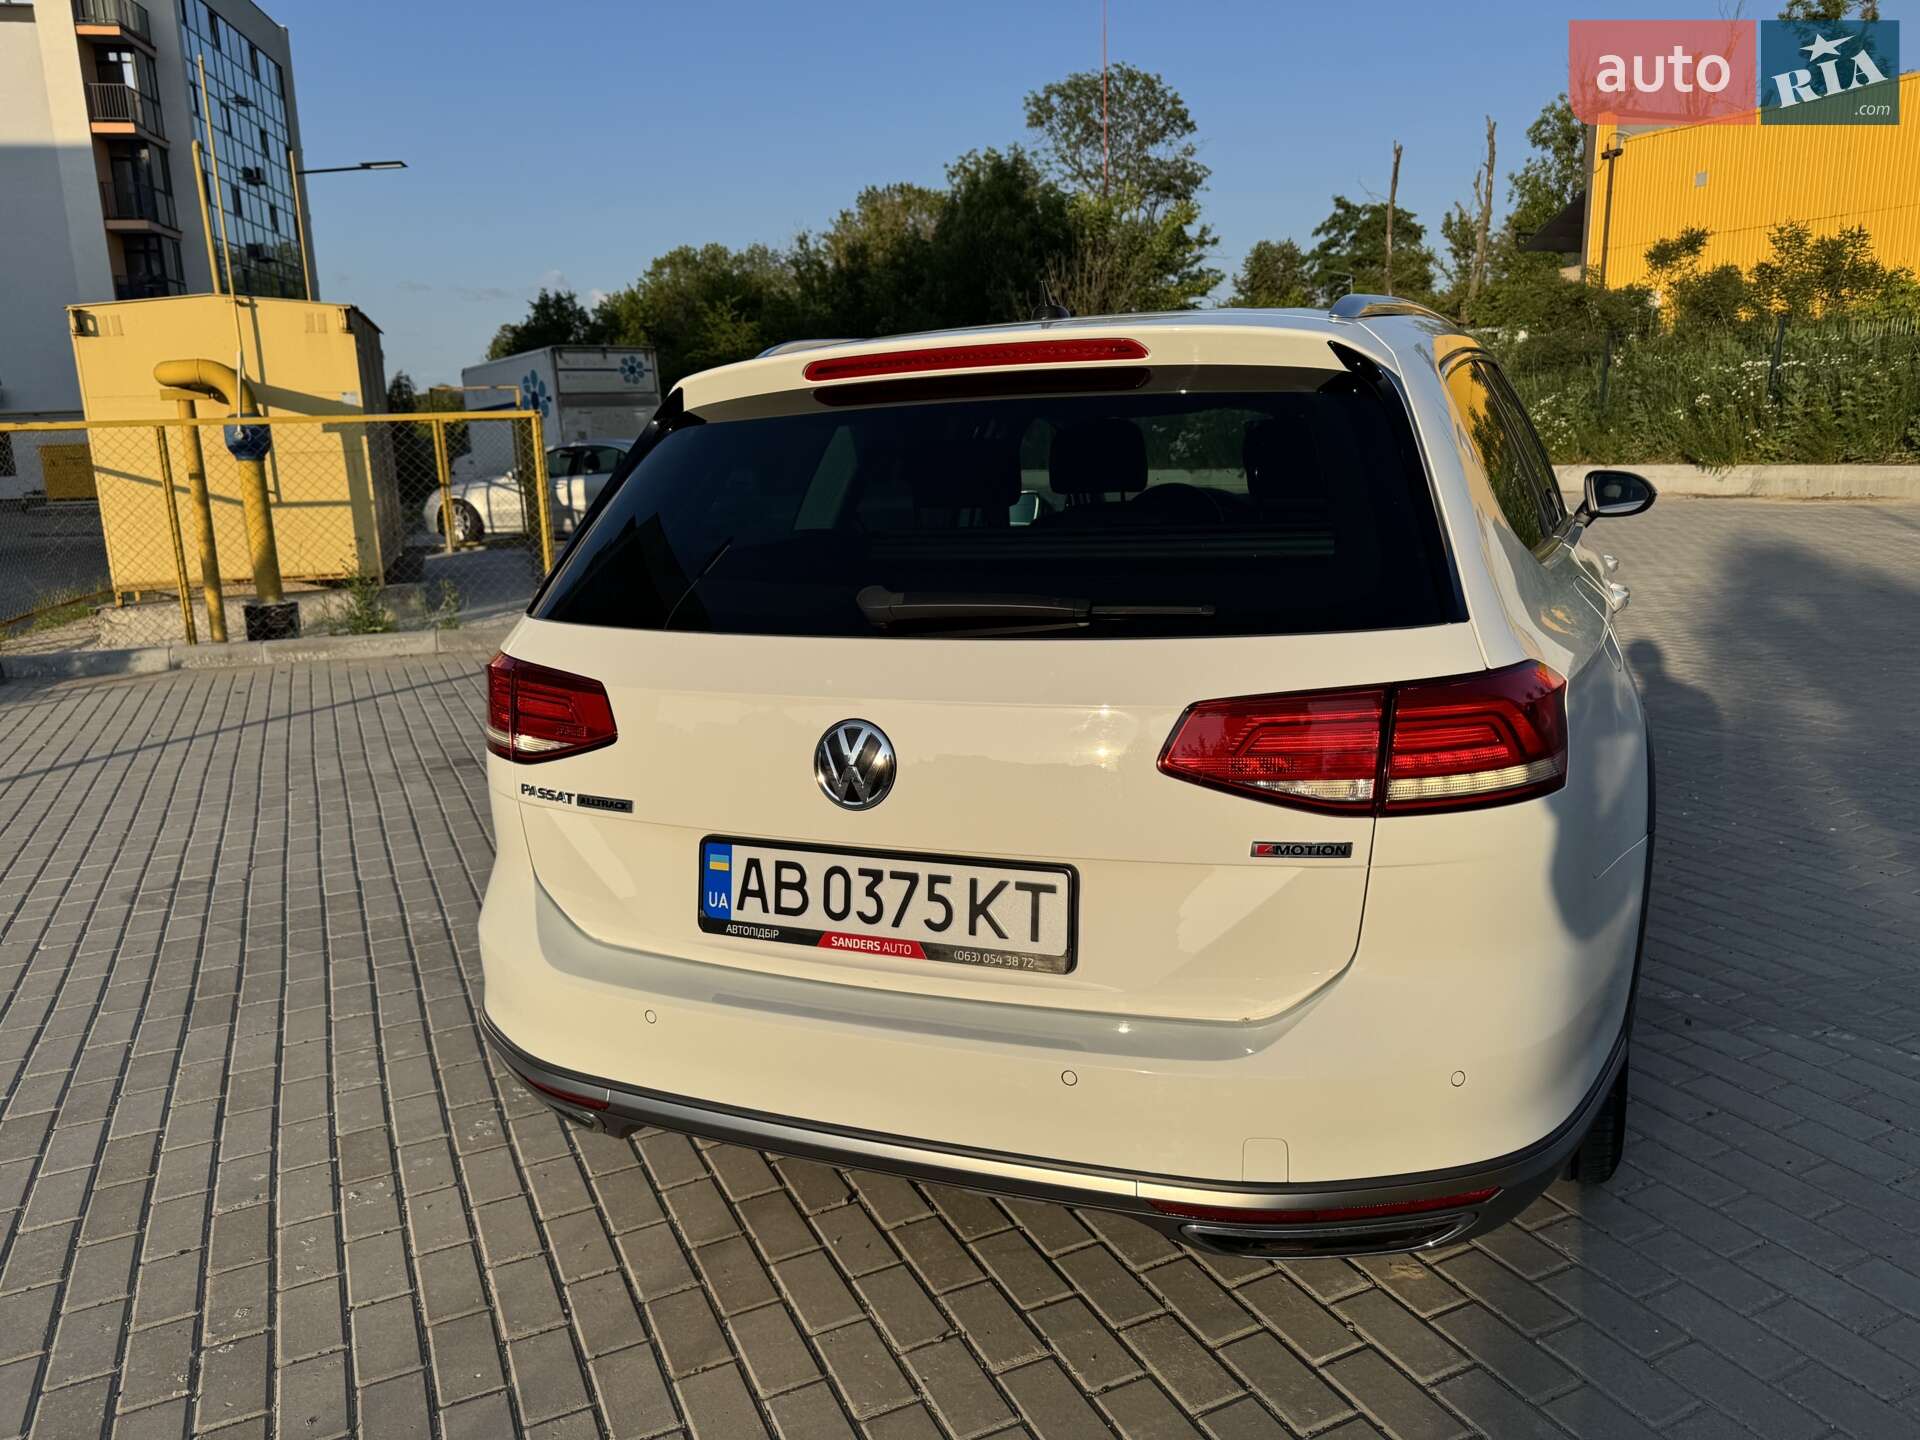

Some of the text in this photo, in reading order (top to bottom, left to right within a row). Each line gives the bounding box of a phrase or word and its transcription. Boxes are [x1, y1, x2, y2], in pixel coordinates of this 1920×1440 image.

[521, 783, 575, 804] PASSAT
[708, 891, 729, 909] UA
[831, 936, 912, 955] SANDERS AUTO
[954, 950, 1034, 968] (063) 054 38 72
